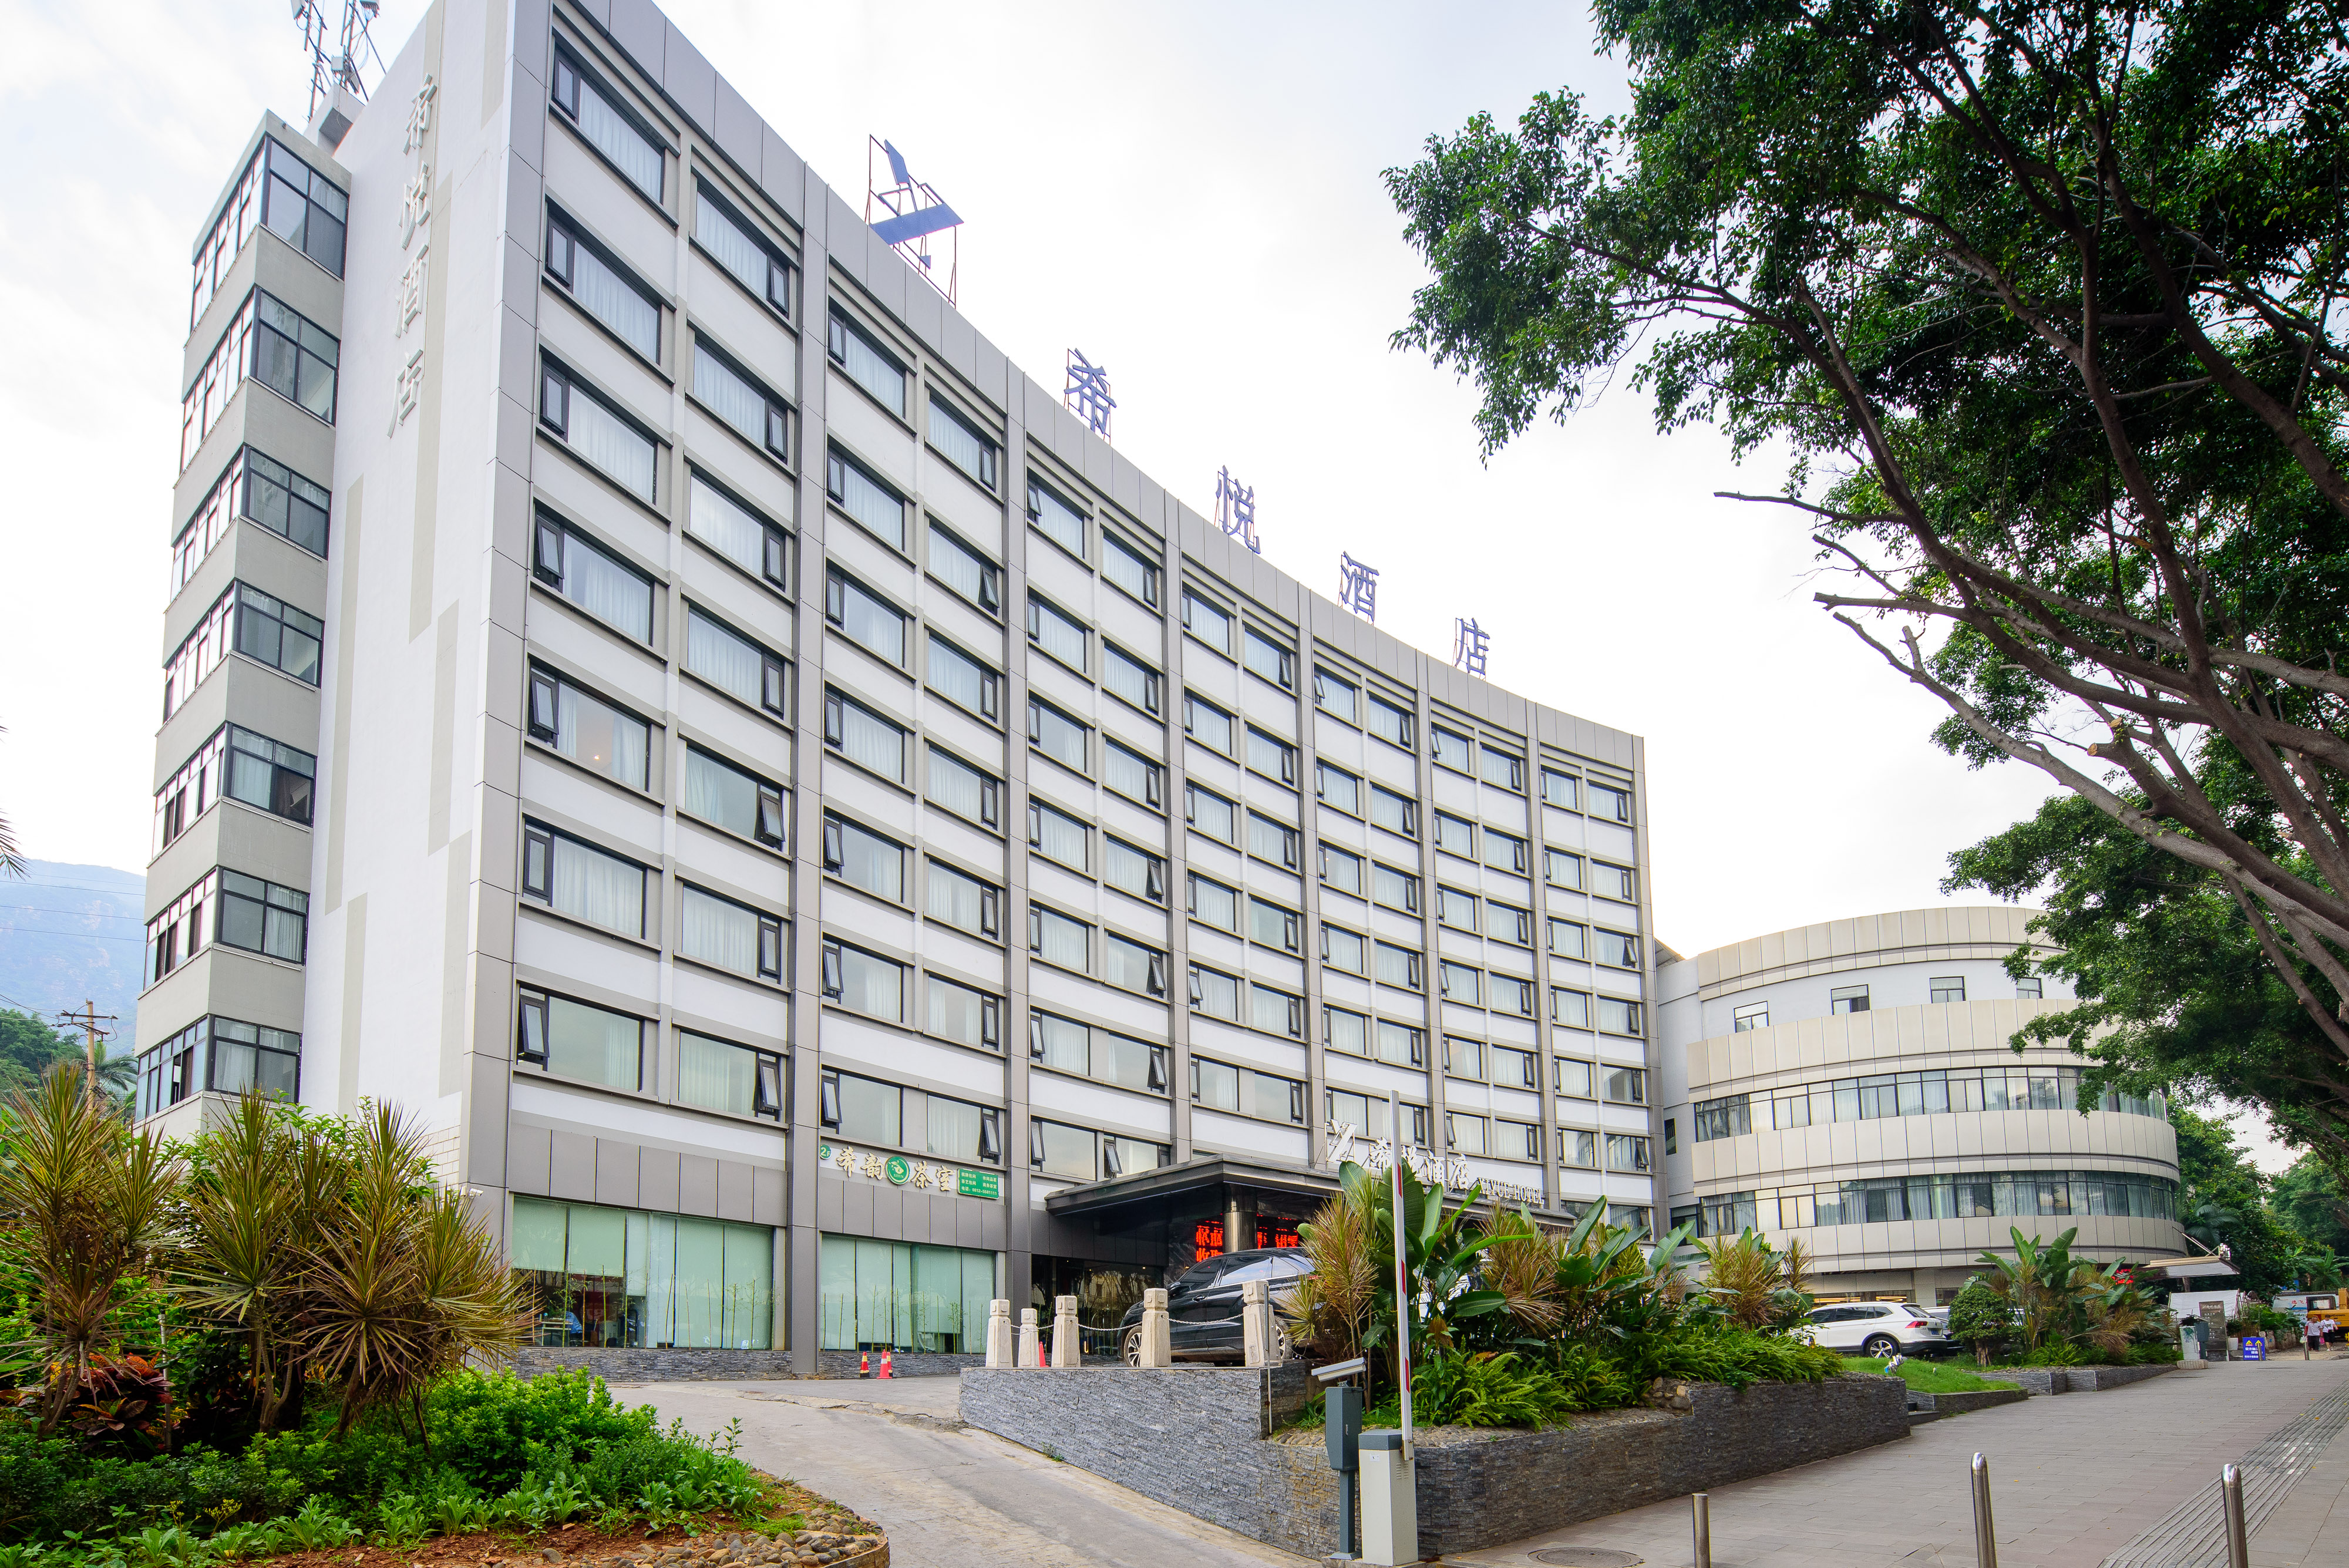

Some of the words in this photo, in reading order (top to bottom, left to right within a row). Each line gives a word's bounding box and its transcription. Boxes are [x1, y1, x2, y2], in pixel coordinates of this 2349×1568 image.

[387, 72, 437, 438] 希悦酒店
[1064, 348, 1490, 675] 希悦酒店
[820, 1147, 831, 1157] 2F
[1477, 1177, 1510, 1199] XIYUE
[1513, 1184, 1544, 1205] HOTEL
